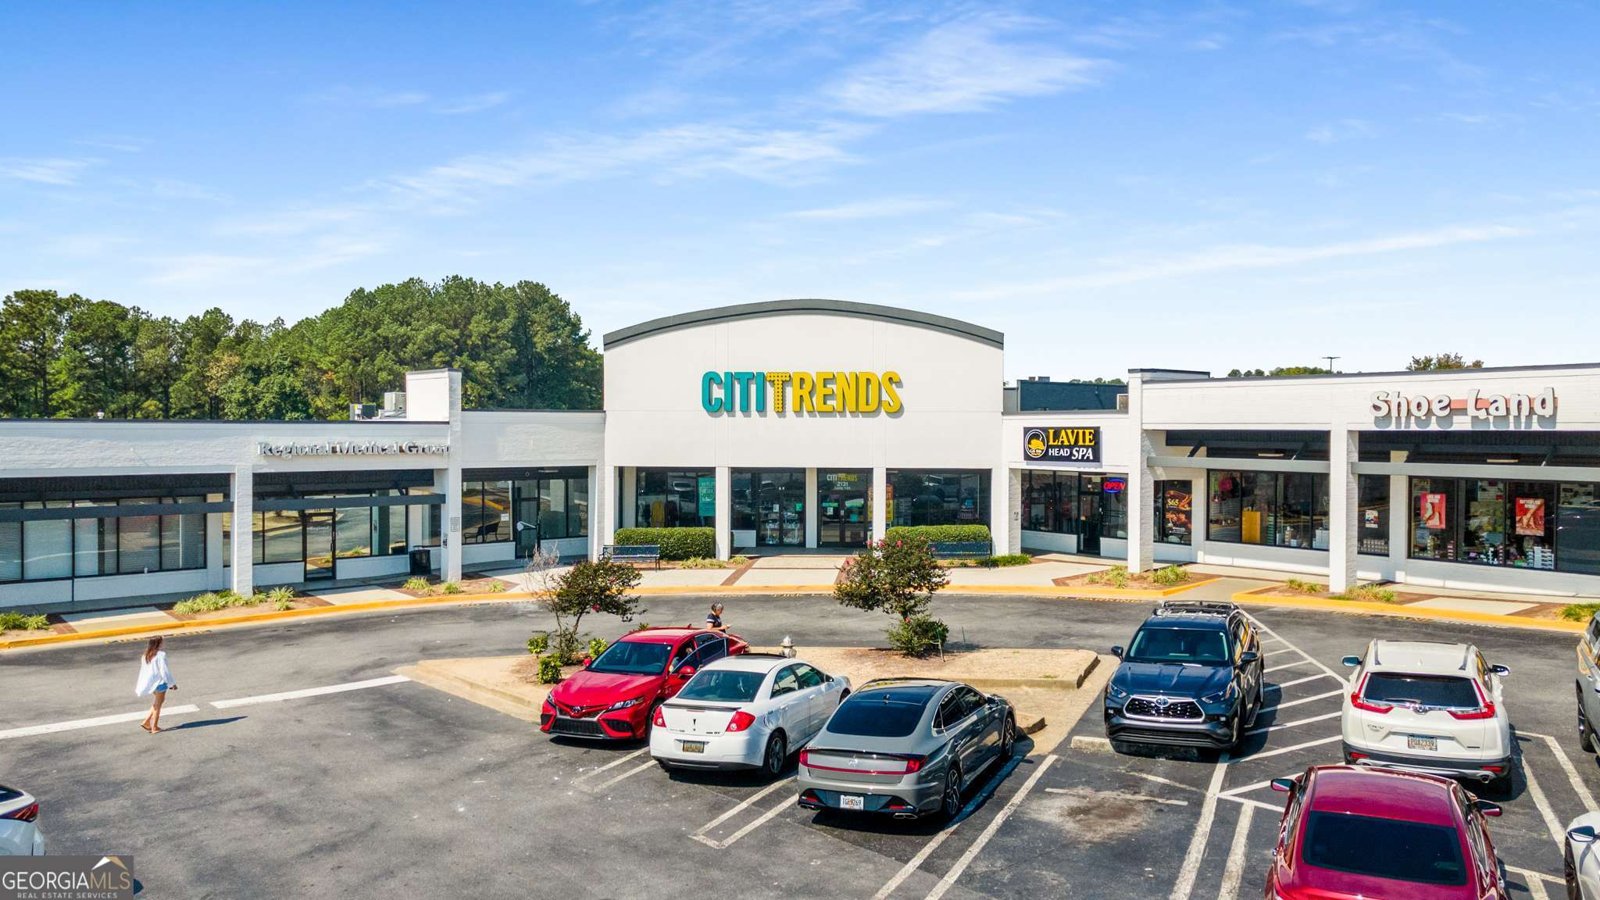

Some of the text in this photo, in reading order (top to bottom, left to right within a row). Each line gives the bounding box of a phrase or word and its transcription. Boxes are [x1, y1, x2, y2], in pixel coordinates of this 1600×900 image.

[701, 371, 901, 413] CITITRENDS
[1370, 386, 1556, 420] Shoe Land
[1047, 428, 1095, 446] LAVIE
[257, 441, 332, 459] Regional
[335, 441, 399, 456] Medical
[1048, 448, 1071, 457] HEAD
[1071, 447, 1094, 460] SPA
[1103, 481, 1126, 491] OPEN
